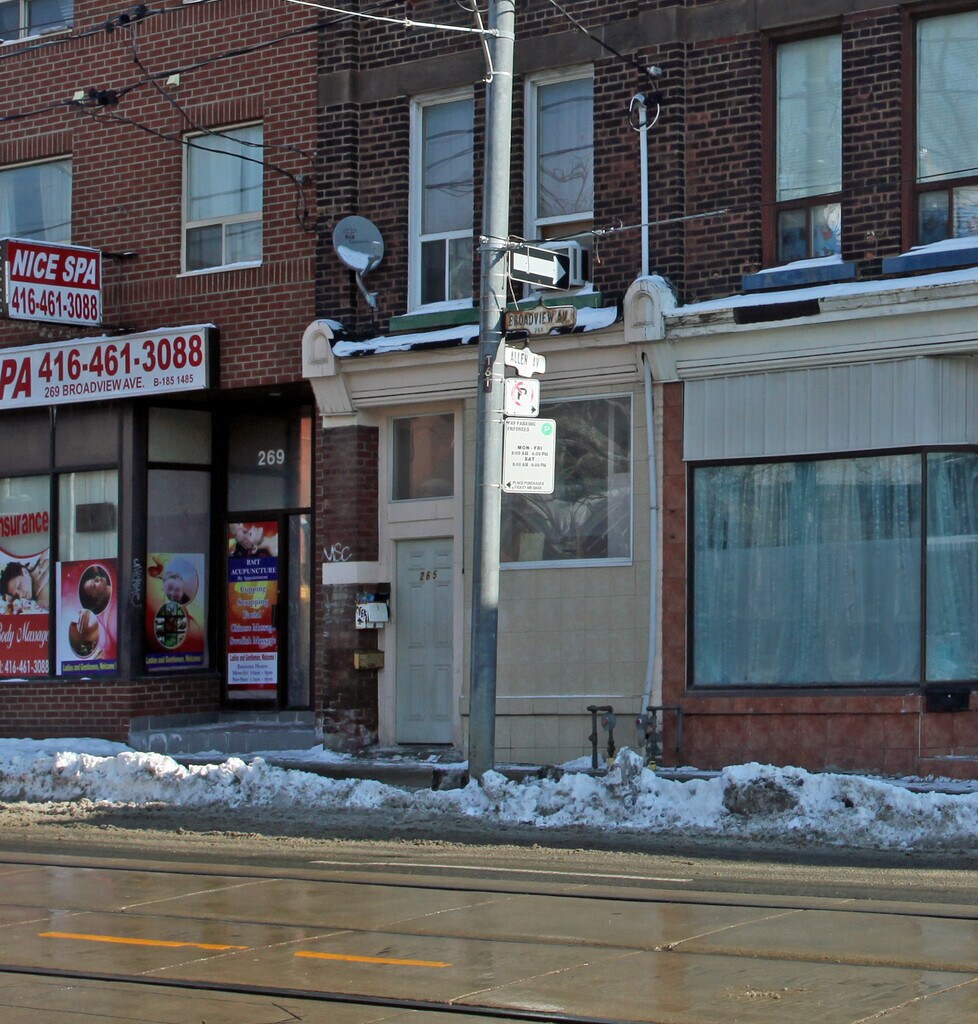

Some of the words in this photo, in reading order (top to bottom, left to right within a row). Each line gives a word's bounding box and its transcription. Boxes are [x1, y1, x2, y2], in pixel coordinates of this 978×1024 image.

[12, 249, 60, 280] NICE
[62, 255, 97, 285] SPA
[12, 286, 98, 321] 416-461-3088
[508, 311, 553, 326] BROADVIEW
[38, 334, 203, 384] 416-461-3088
[510, 350, 529, 366] ALLEN
[532, 356, 541, 368] AV
[44, 385, 60, 398] 269
[62, 378, 122, 396] BROADVIEW
[122, 376, 145, 391] AVE.
[153, 375, 175, 387] B-185
[176, 374, 194, 385] 1485
[258, 449, 285, 466] 269
[230, 566, 278, 576] ACUPUNCTURE
[420, 570, 438, 582] 265
[240, 586, 267, 595] Cupping
[16, 621, 50, 649] Massage
[5, 659, 50, 674] 416-461-3088
